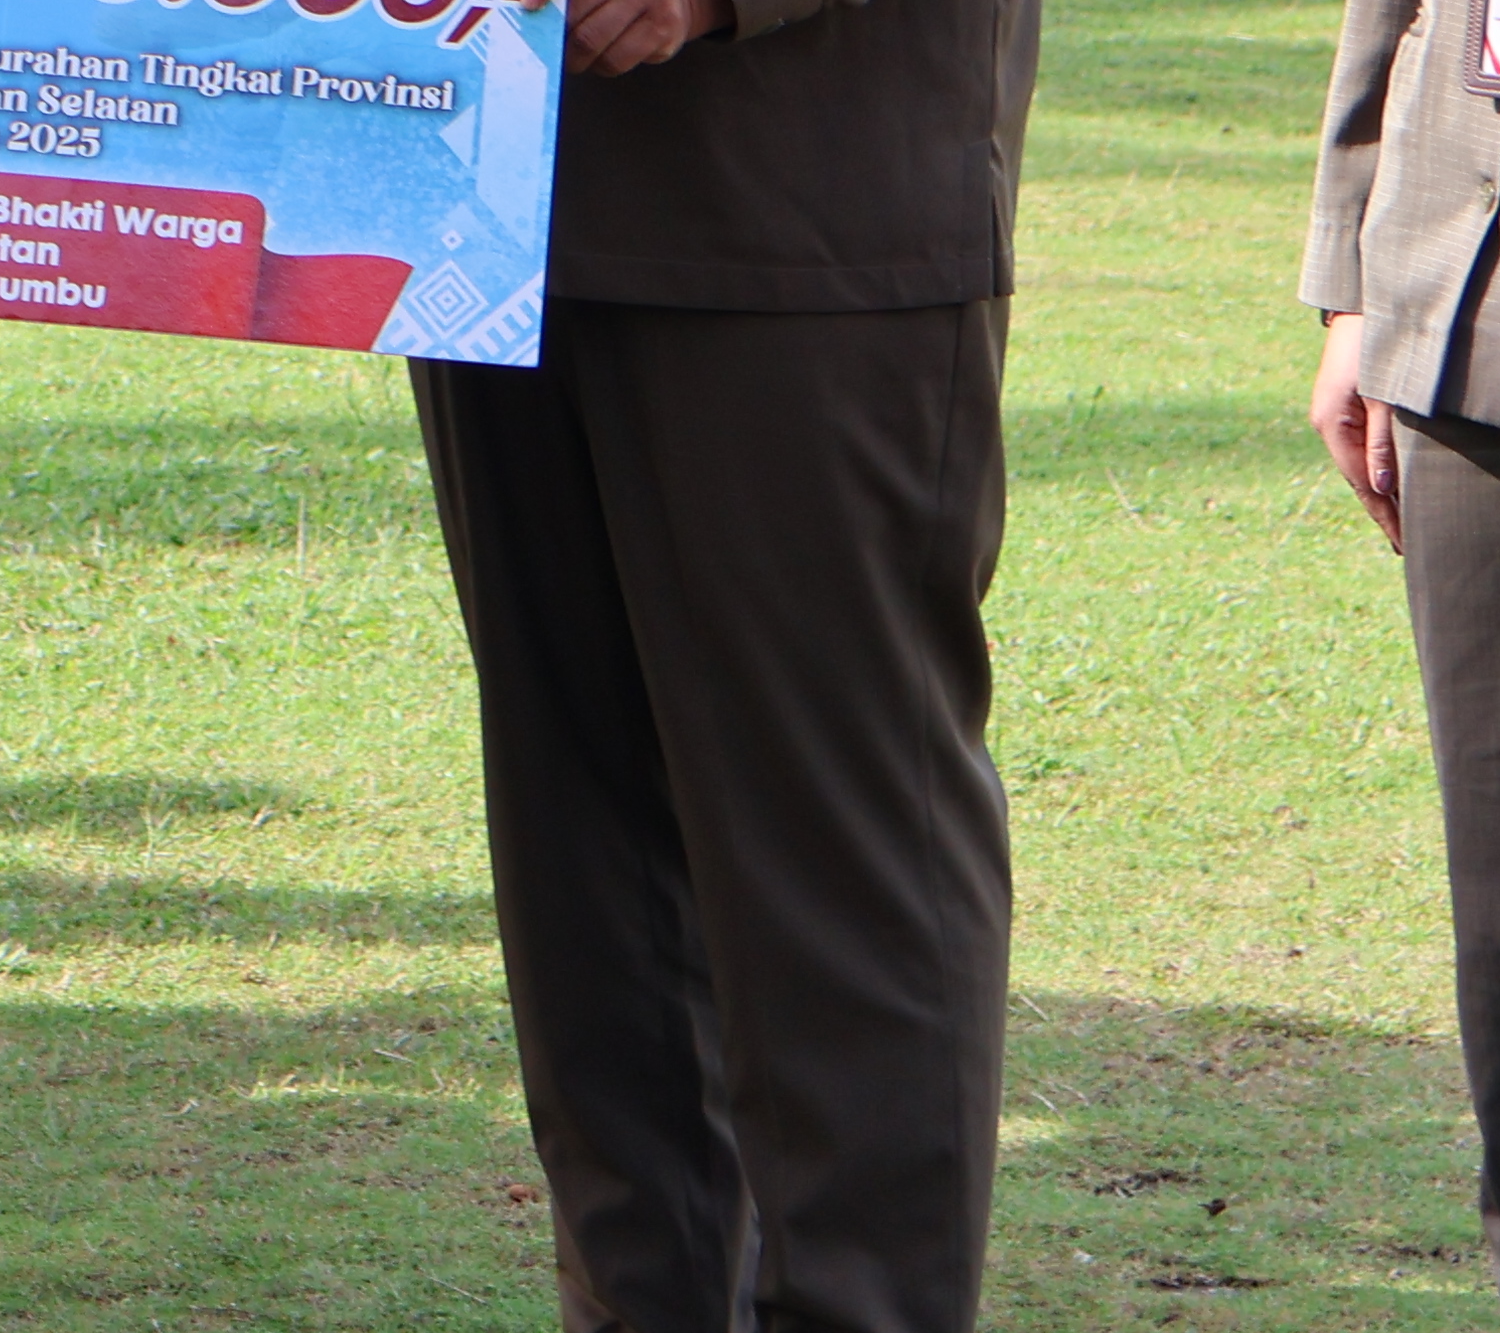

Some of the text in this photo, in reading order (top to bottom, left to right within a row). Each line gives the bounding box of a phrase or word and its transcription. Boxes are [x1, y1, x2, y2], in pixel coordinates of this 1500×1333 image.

[140, 52, 284, 97] Tingkat
[291, 66, 455, 112] Provinsi
[37, 84, 179, 126] Selatan
[6, 120, 102, 159] 2025
[113, 204, 244, 248] Warga
